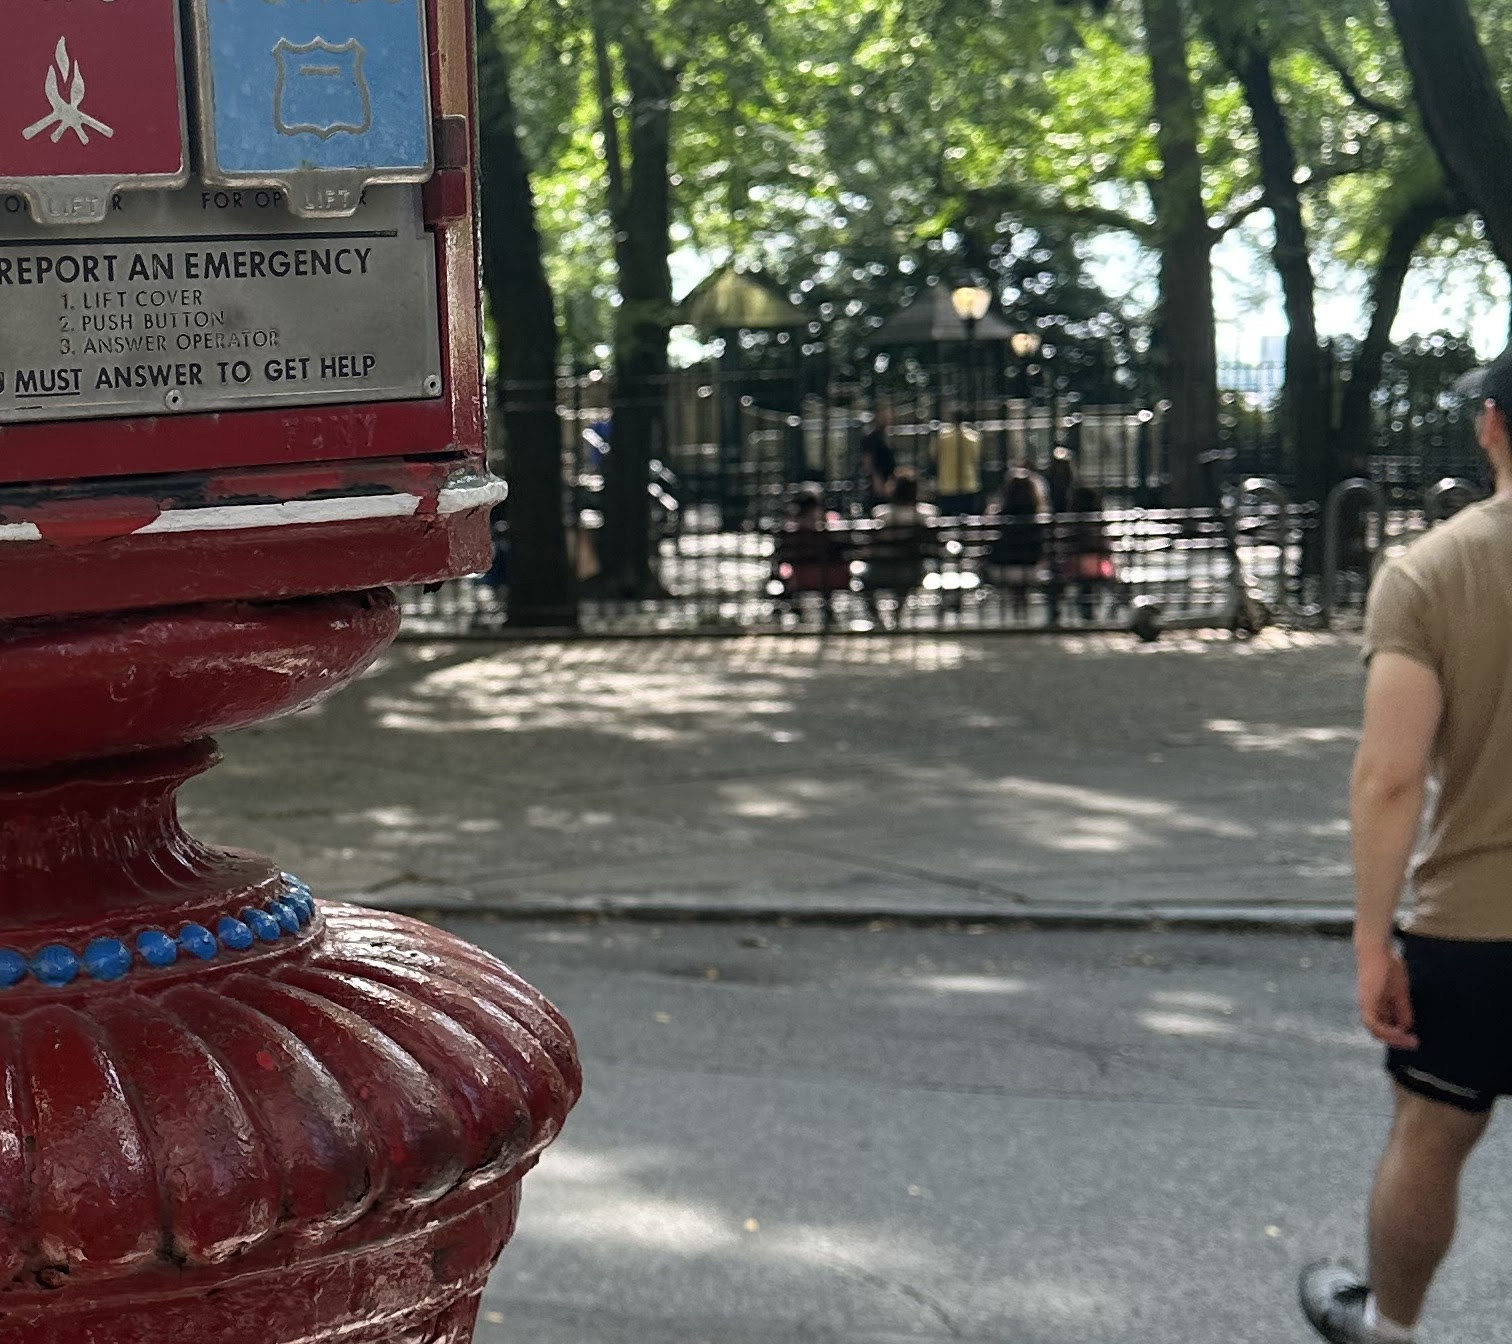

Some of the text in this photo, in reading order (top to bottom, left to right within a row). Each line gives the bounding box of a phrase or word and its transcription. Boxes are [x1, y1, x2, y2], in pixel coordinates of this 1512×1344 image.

[49, 196, 99, 217] LIFT
[201, 191, 244, 209] FOR
[304, 189, 351, 210] LIFT
[128, 252, 174, 281] AN
[184, 247, 372, 280] EMERGENCY
[61, 289, 203, 310] 1. LIFT COVER
[59, 310, 225, 333] 2. PUSH BUTTON
[59, 328, 281, 355] 3. ANSWER OPERATOR
[14, 367, 82, 394] MUST
[95, 362, 204, 390] ANSWER
[216, 360, 252, 385] TO
[264, 357, 311, 382] GET
[319, 354, 376, 379] HELP
